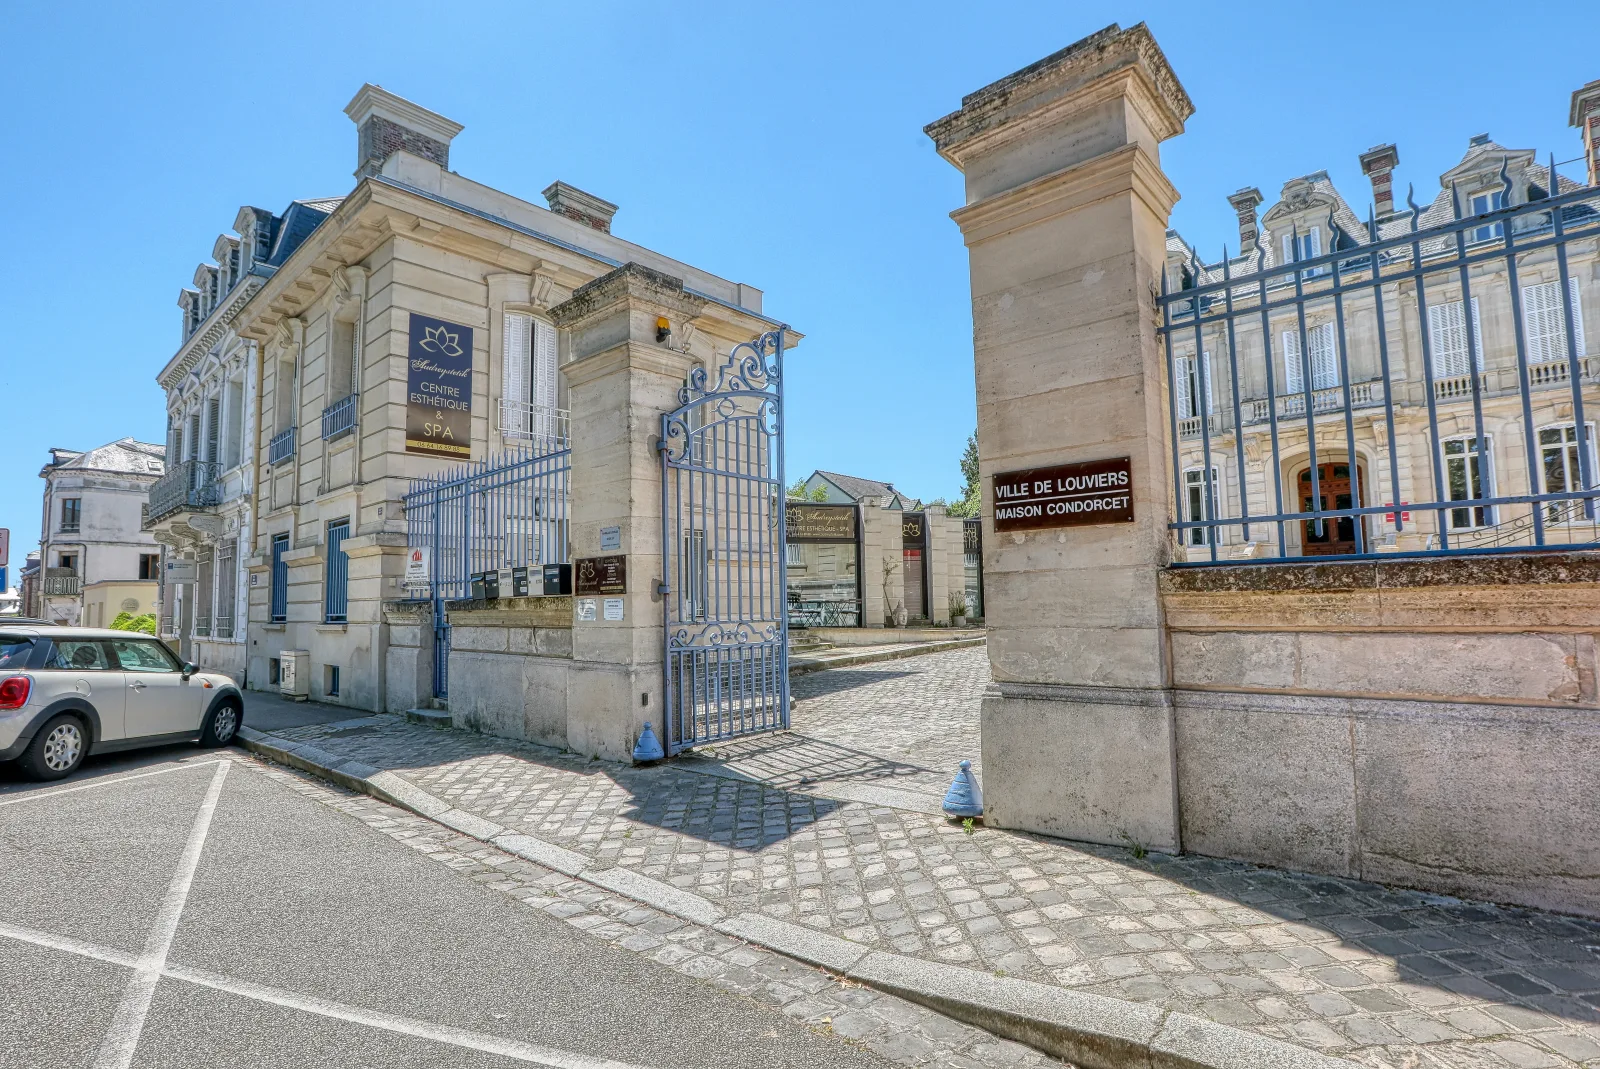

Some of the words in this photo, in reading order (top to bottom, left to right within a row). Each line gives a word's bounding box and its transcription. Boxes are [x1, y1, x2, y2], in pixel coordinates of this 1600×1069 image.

[421, 382, 459, 397] CENTRE
[410, 393, 468, 411] ESTHÉTIQUE
[436, 411, 443, 420] &
[423, 422, 454, 440] SPA
[995, 483, 1029, 498] VILLE
[1034, 480, 1052, 495] DE
[1057, 471, 1128, 492] LOUVIERS
[995, 505, 1042, 520] MAISON
[1046, 496, 1129, 515] CONDORCET
